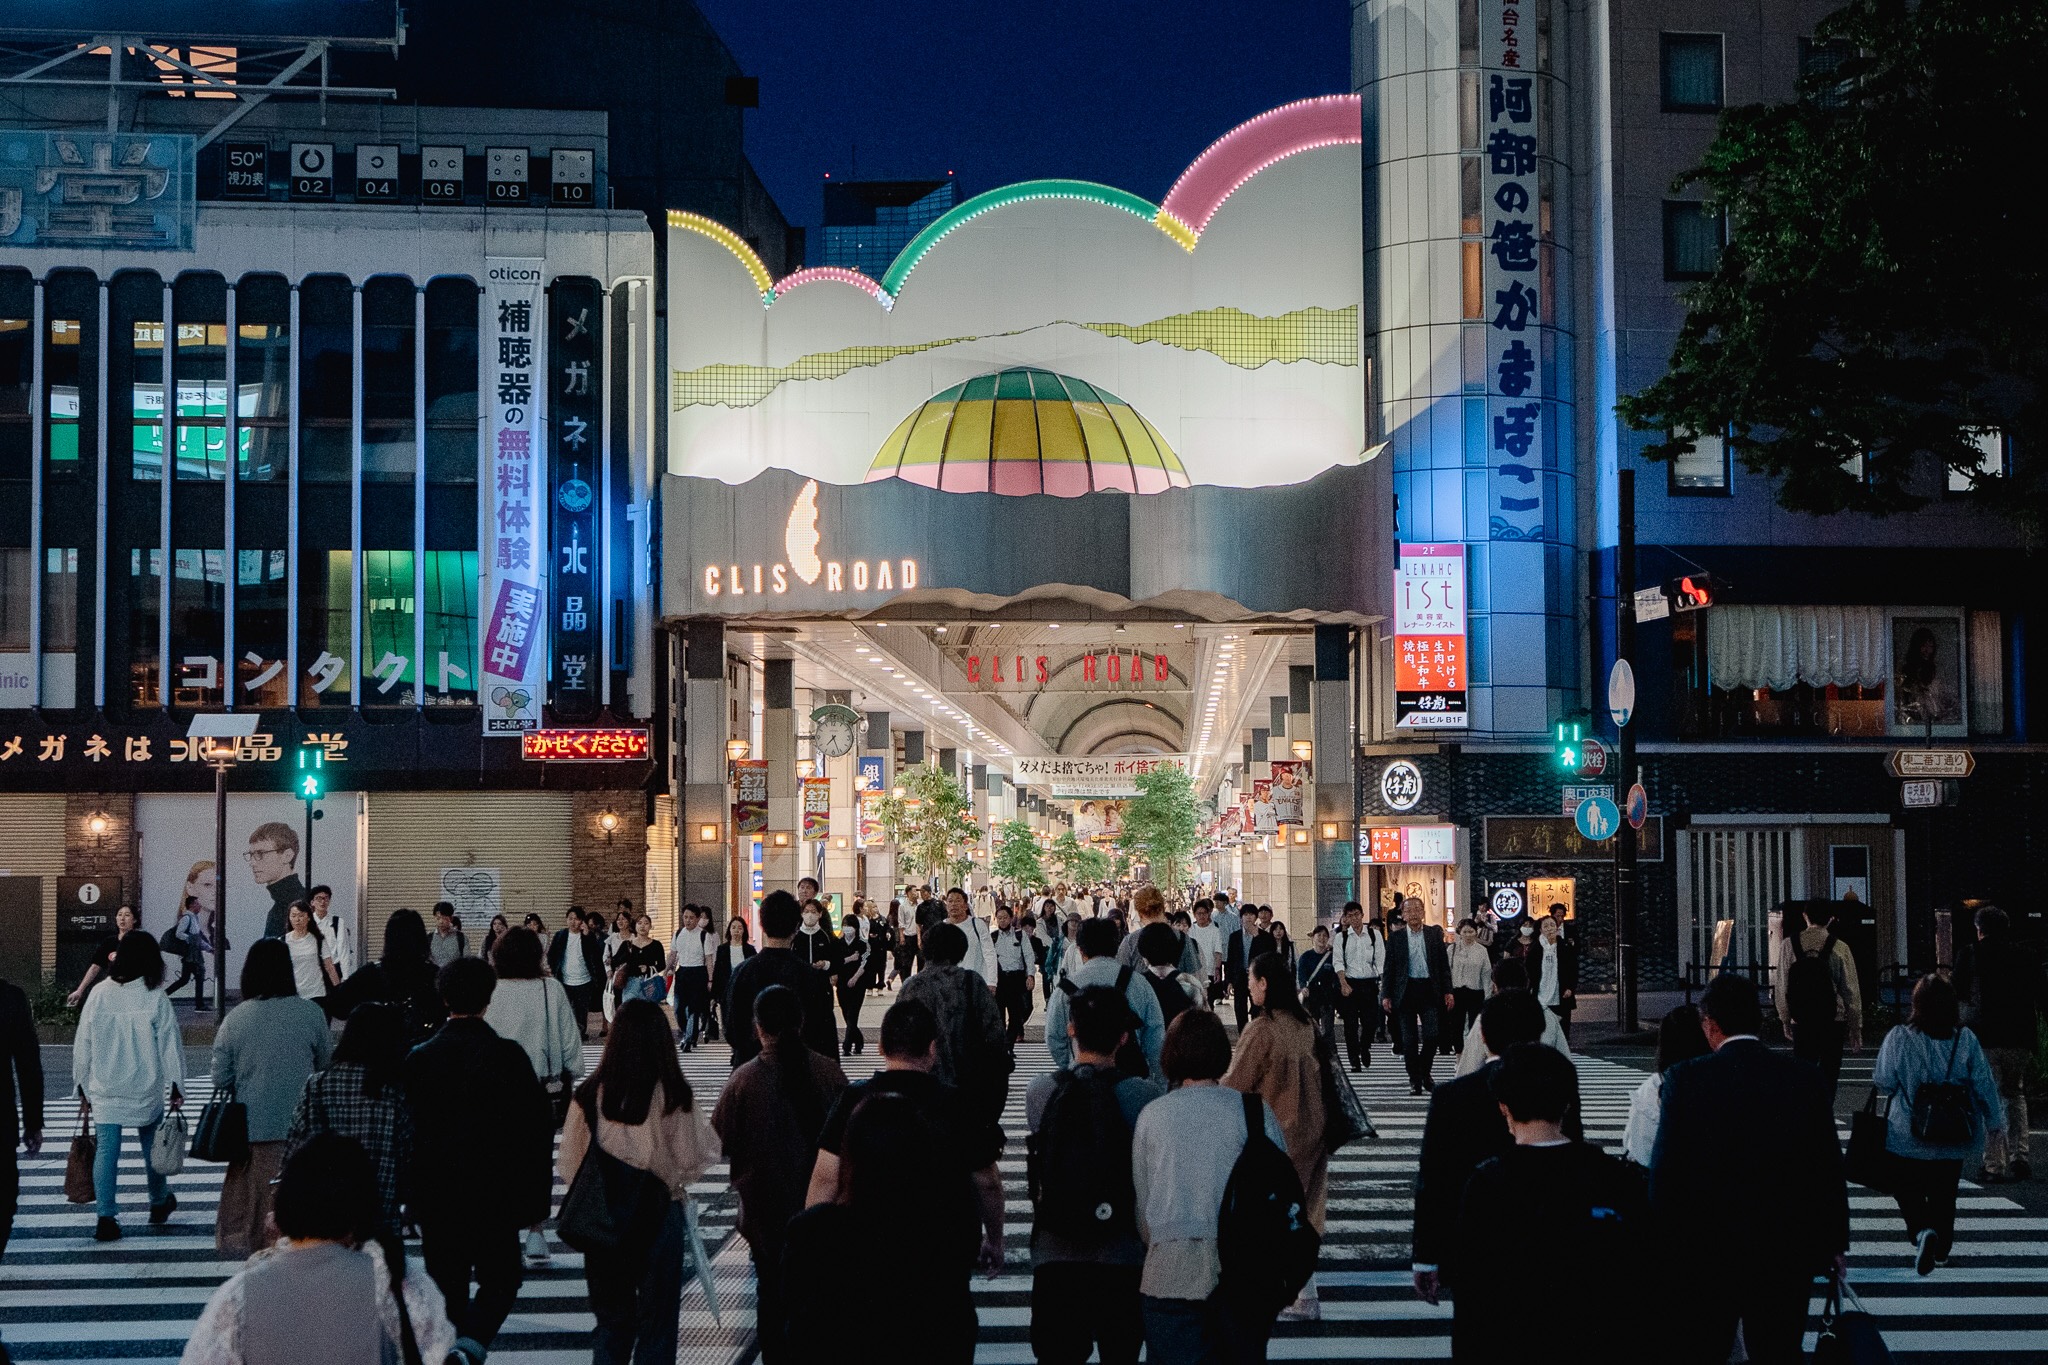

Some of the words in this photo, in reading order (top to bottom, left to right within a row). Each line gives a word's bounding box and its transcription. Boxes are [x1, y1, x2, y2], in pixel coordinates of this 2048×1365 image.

[1501, 0, 1520, 68] 台名産
[227, 171, 264, 186] 視力表
[300, 180, 324, 194] 0.2
[365, 181, 389, 195] 0.4
[430, 183, 454, 196] 0.6
[496, 185, 519, 198] 0.8
[562, 186, 582, 199] 1.0
[489, 267, 540, 280] oticon
[1487, 74, 1541, 511] 阿部の笹かまぼこ
[564, 308, 590, 450] メガネ
[498, 300, 531, 569] 補聴器の無料体験
[1422, 546, 1435, 555] 2F
[705, 564, 787, 595] CLIS
[827, 559, 918, 591] ROAD
[1405, 563, 1452, 576] LENAHC
[560, 538, 588, 690] 水晶堂
[490, 588, 537, 673] 実施中
[1402, 640, 1416, 669] 焼肉。
[181, 650, 468, 694] コンタクト
[967, 655, 1049, 683] CLIS
[1083, 655, 1169, 683] ROAD
[1417, 640, 1430, 689] 極上和牛
[1446, 641, 1456, 688] トロける
[491, 720, 534, 730] 水晶堂
[1904, 754, 1964, 766] 東二番丁通り
[740, 774, 766, 788] 全力
[740, 788, 766, 801] 応援
[806, 789, 828, 801] 全力
[806, 801, 828, 812] 応援
[1373, 832, 1381, 859] 牛刺し
[1391, 832, 1399, 859] 焼肉
